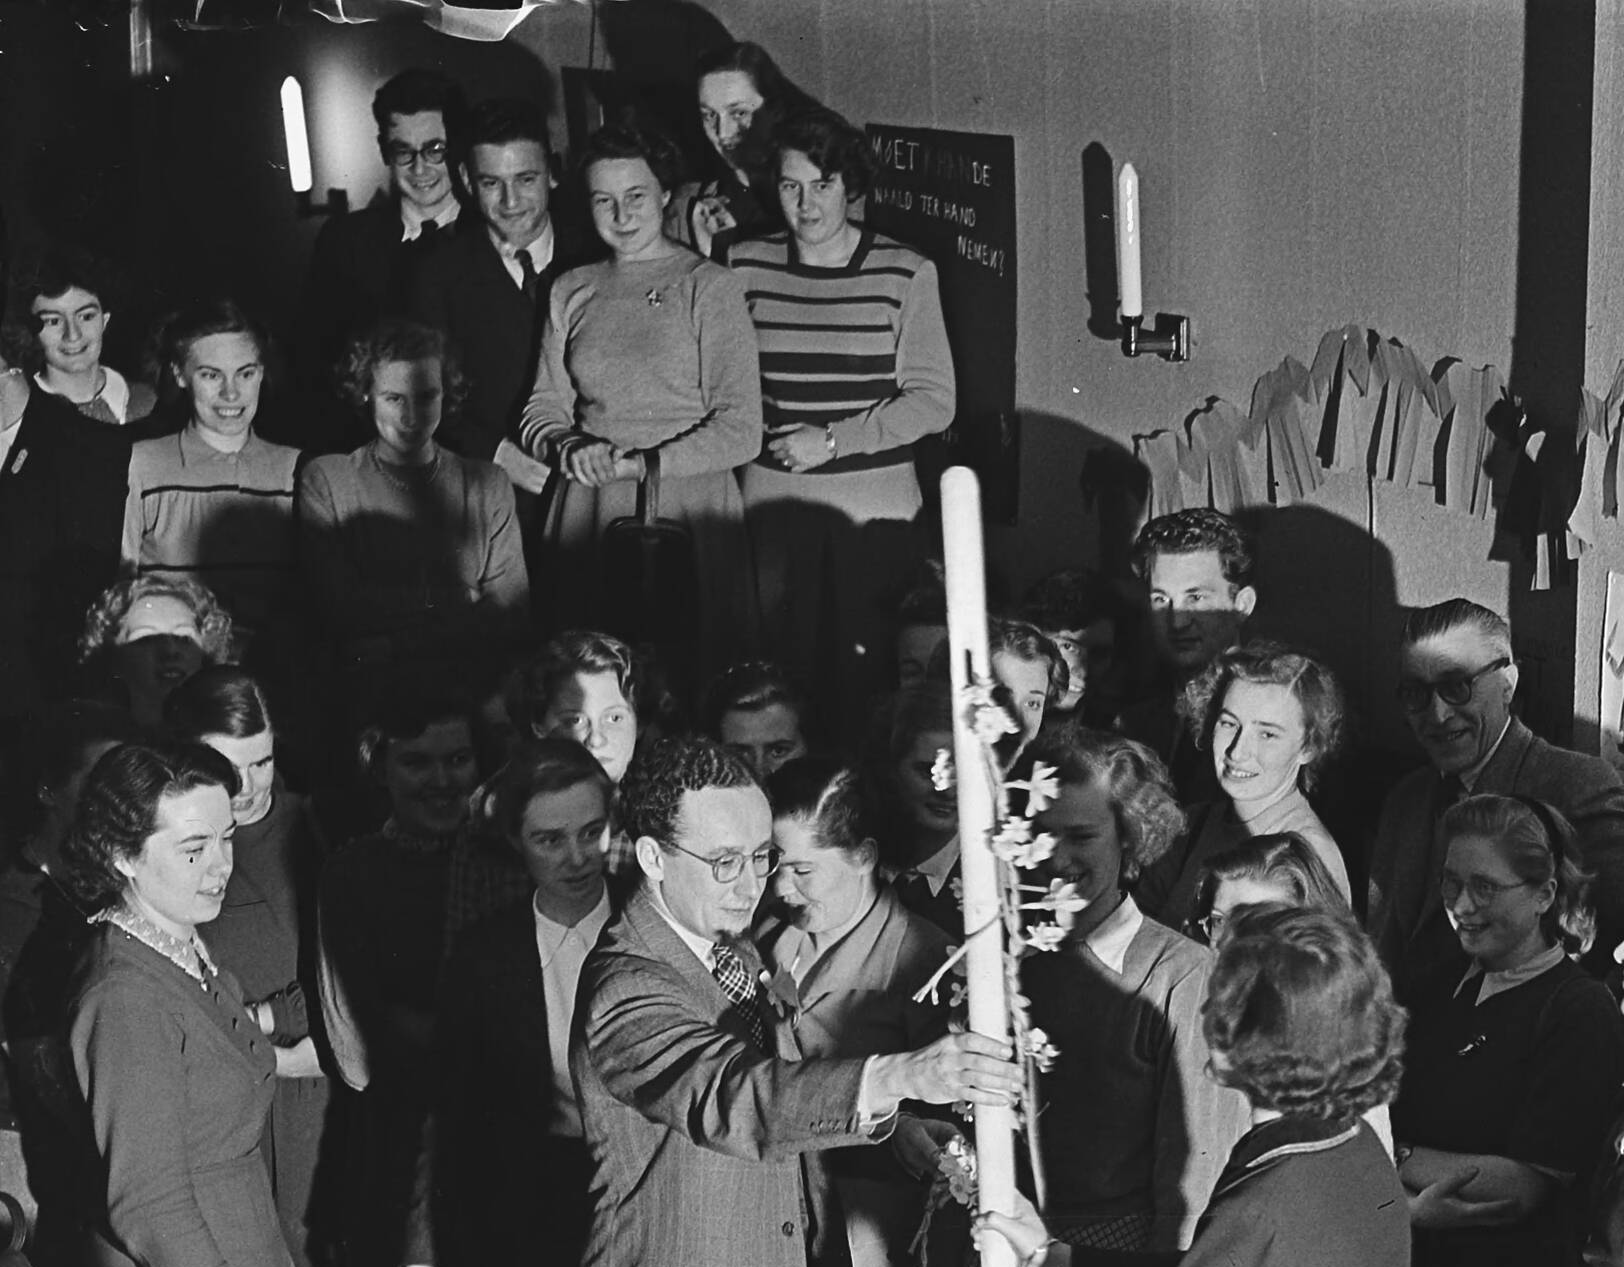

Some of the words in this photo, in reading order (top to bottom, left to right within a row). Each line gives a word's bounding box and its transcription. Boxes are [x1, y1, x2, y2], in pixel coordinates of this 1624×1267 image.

[872, 135, 920, 171] MOET
[972, 161, 992, 187] DE
[919, 195, 940, 217] TER
[944, 203, 977, 227] HAND
